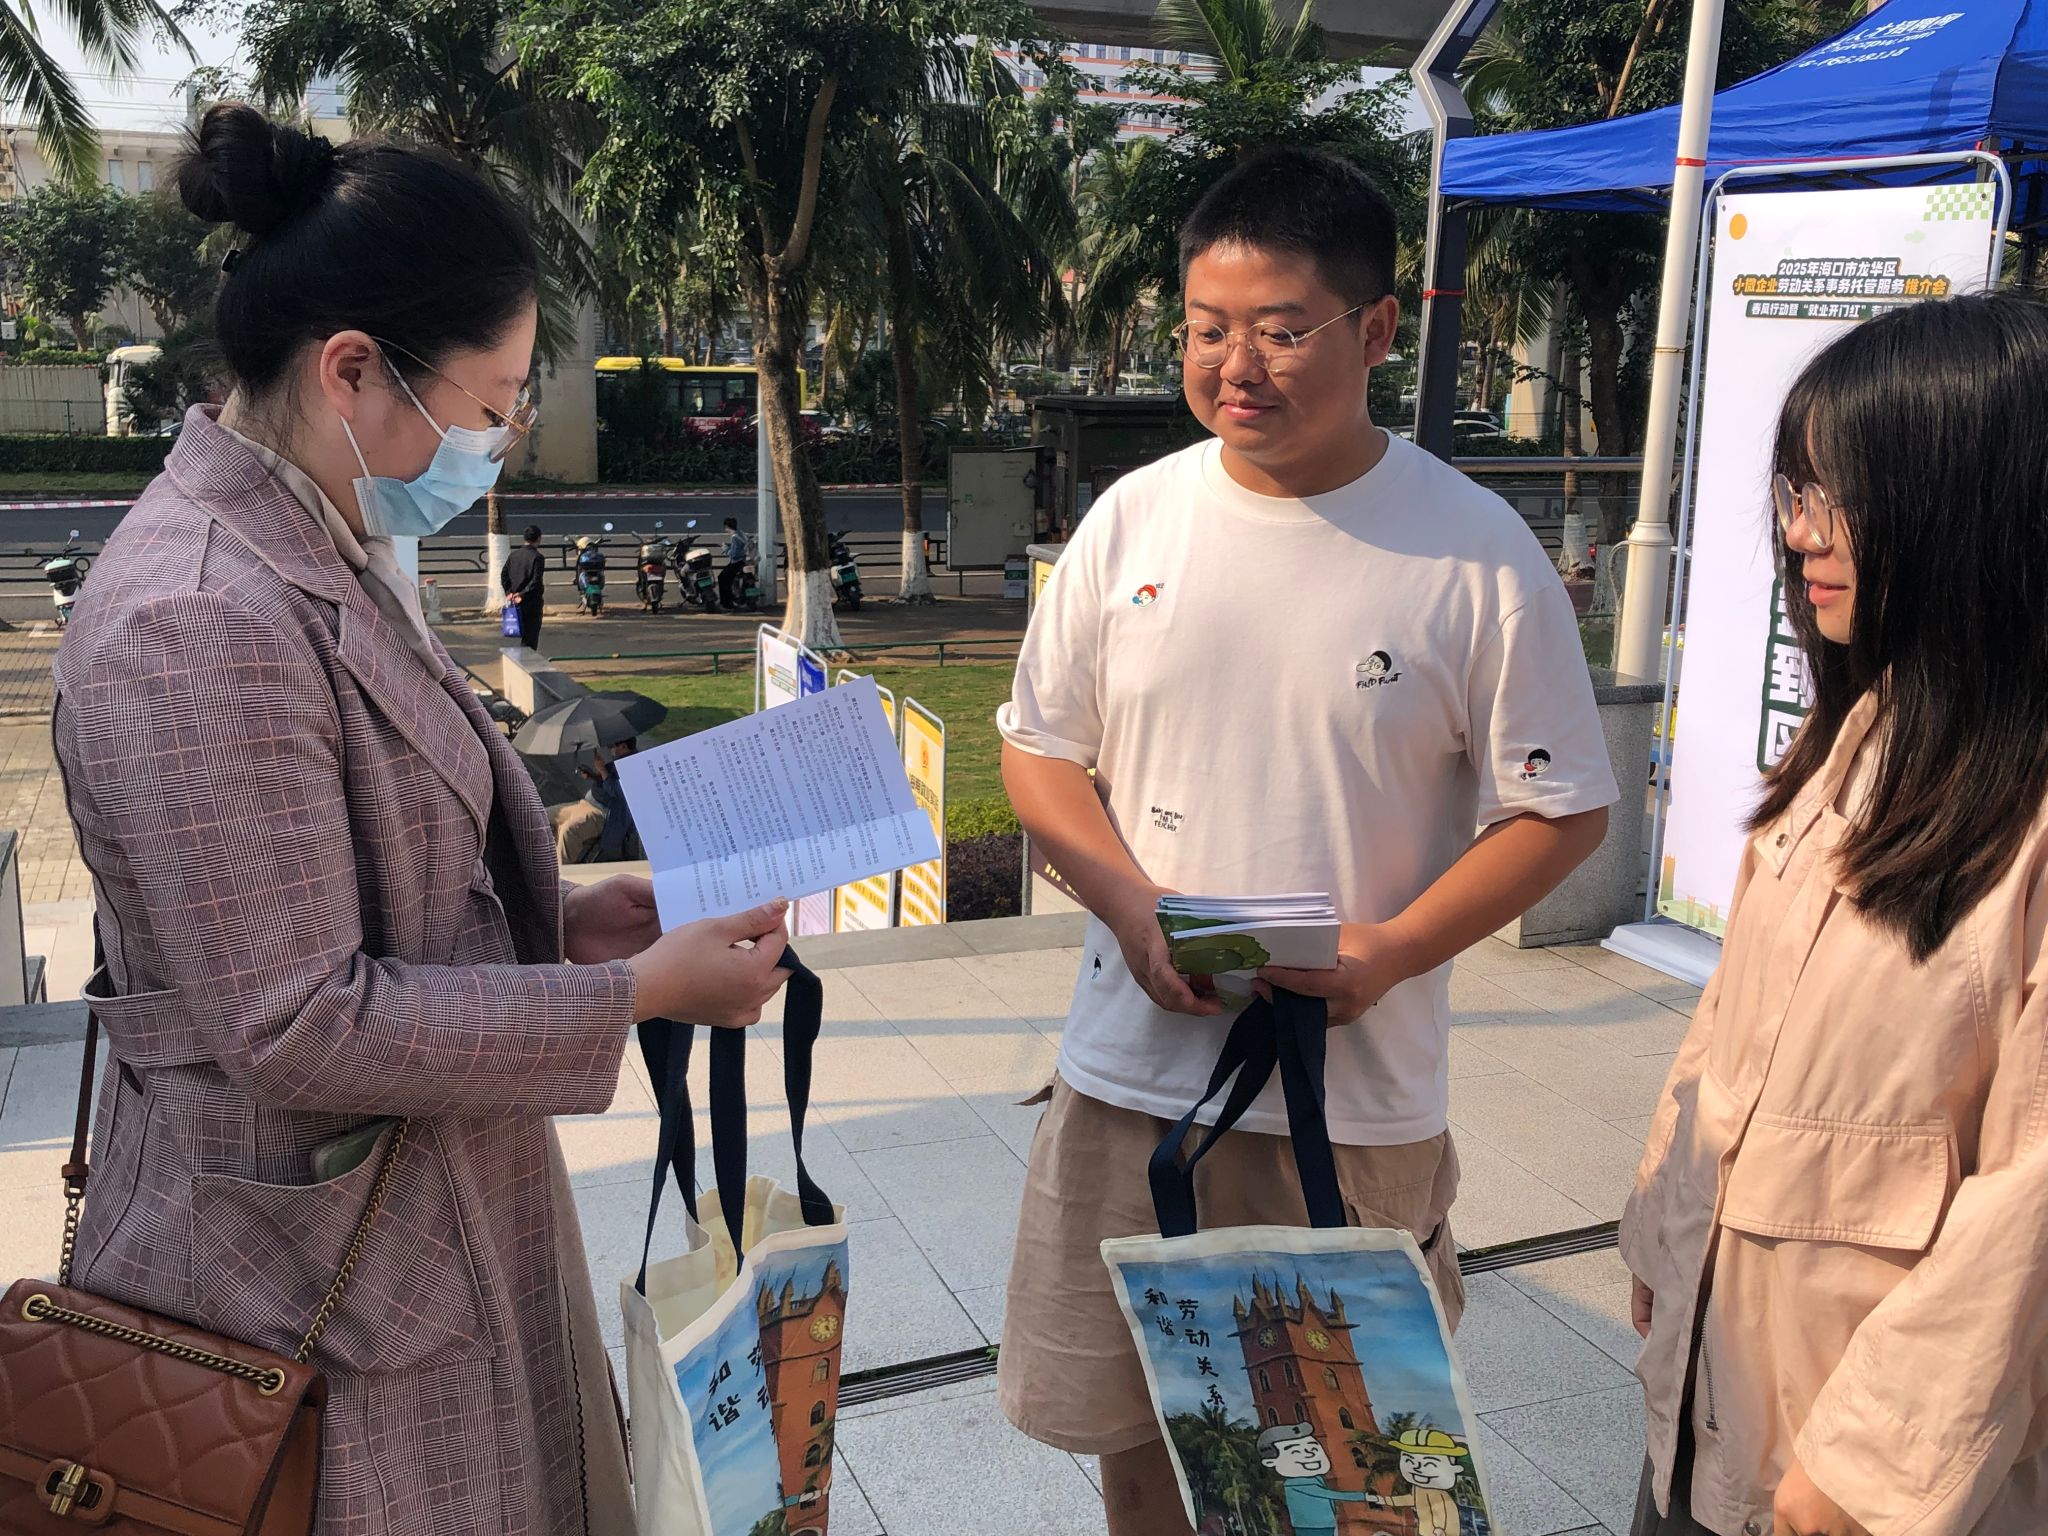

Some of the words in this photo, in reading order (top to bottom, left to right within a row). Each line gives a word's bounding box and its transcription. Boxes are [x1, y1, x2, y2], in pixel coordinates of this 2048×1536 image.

[1778, 260, 1898, 278] 2025年海口市龙华区
[1176, 1298, 1226, 1406] 劳动关系
